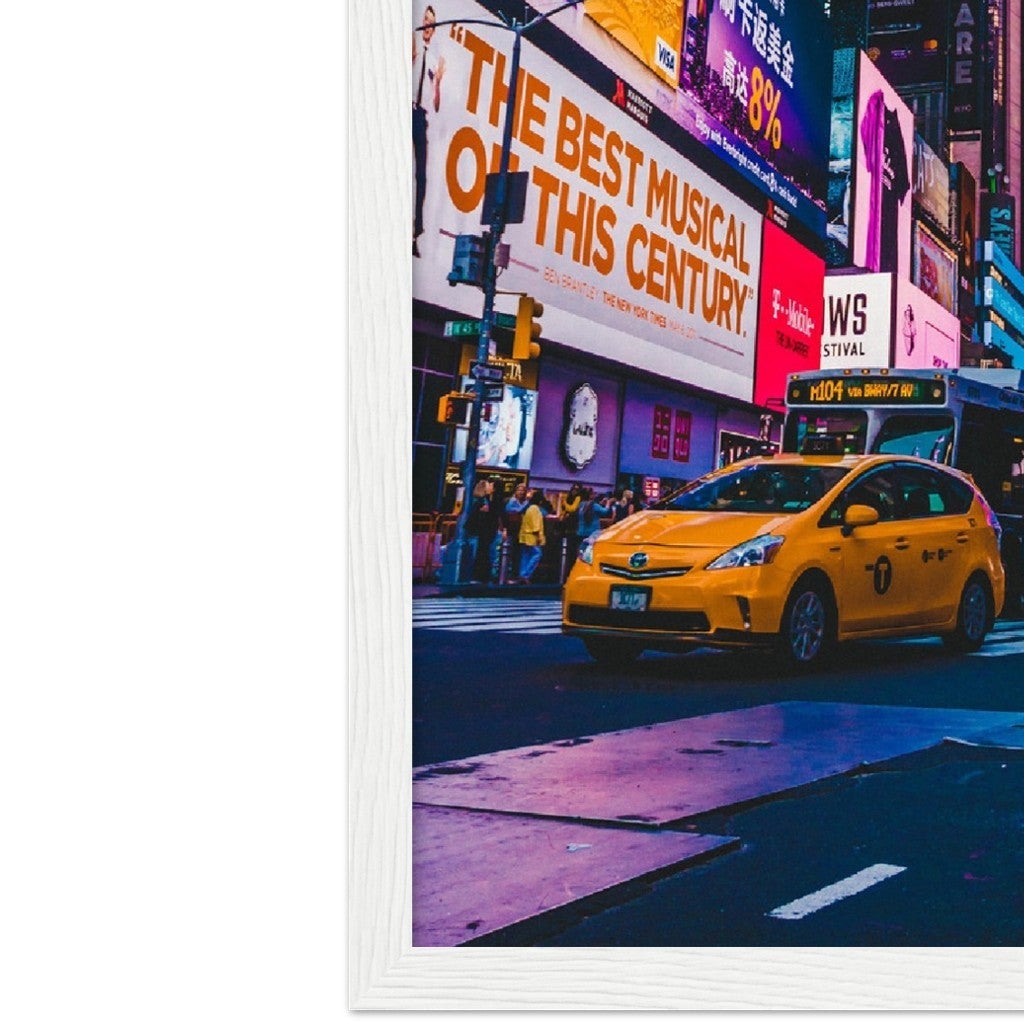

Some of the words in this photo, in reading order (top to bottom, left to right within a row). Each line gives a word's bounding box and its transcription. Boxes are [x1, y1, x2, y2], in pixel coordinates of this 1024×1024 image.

[658, 44, 676, 70] VISA
[748, 65, 782, 150] 8%
[555, 95, 645, 207] BEST
[646, 157, 750, 275] MUSICAL
[532, 165, 618, 276] THIS
[602, 291, 616, 307] THE
[616, 296, 631, 313] NEW
[821, 293, 867, 336] WS
[820, 342, 866, 358] STIVAL
